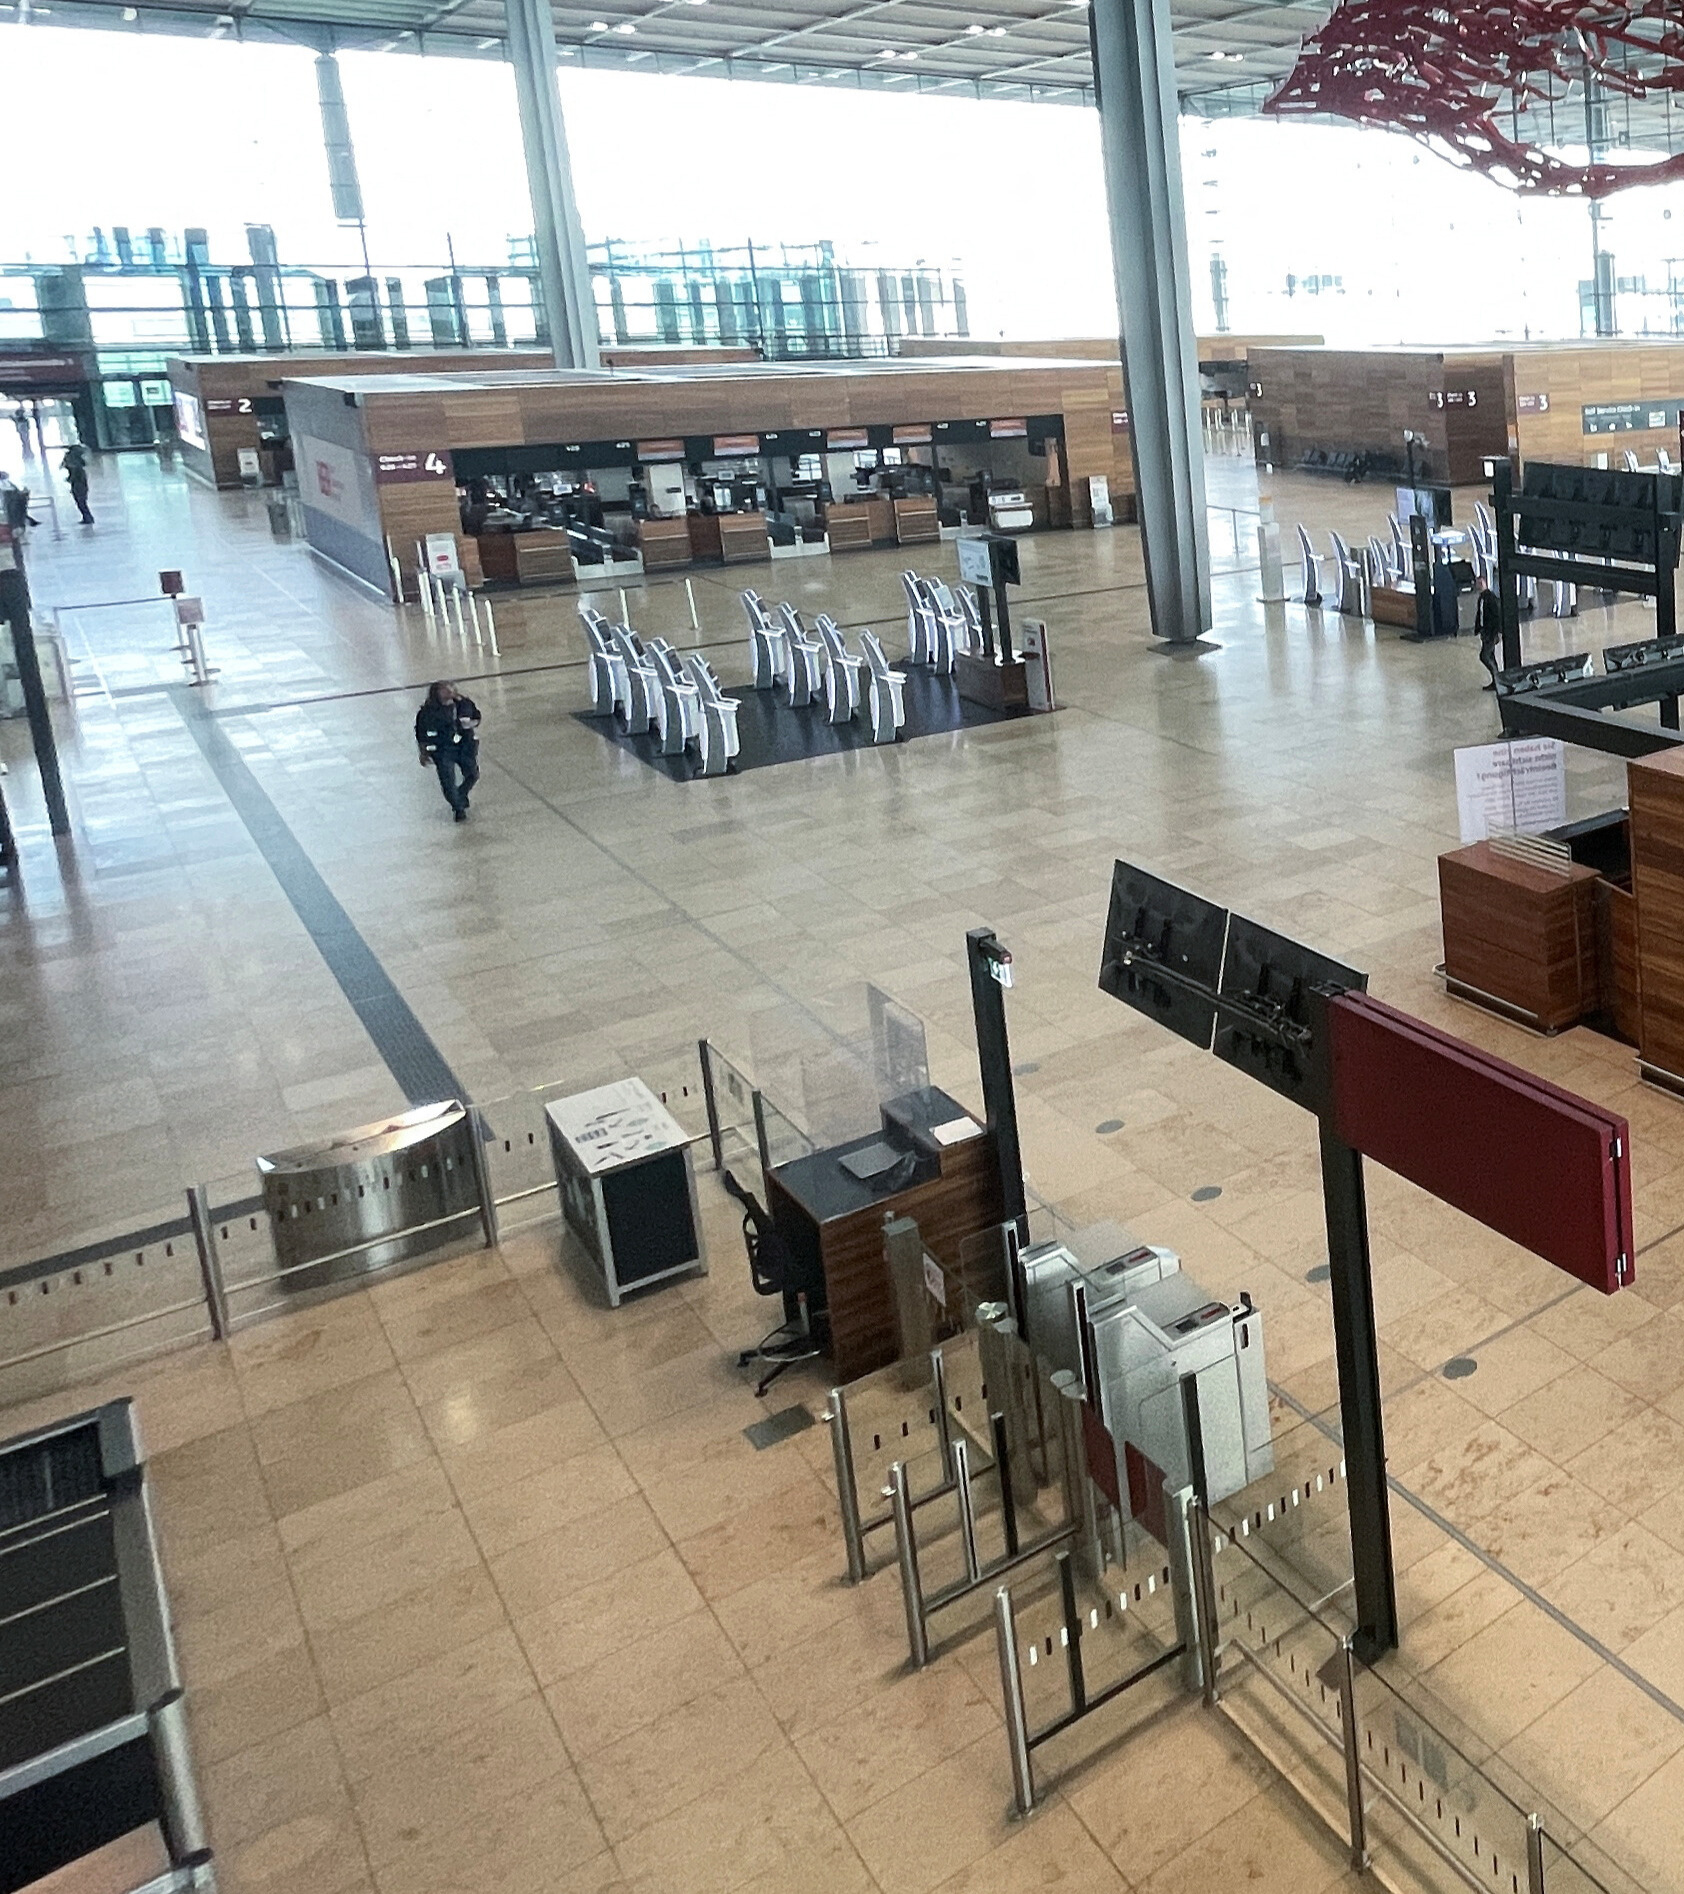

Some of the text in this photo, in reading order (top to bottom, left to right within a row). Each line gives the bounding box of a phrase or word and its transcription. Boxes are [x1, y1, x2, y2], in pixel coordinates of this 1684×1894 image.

[238, 398, 253, 413] 2
[1467, 391, 1477, 407] 3
[1539, 394, 1549, 411] 3
[425, 452, 447, 475] 4
